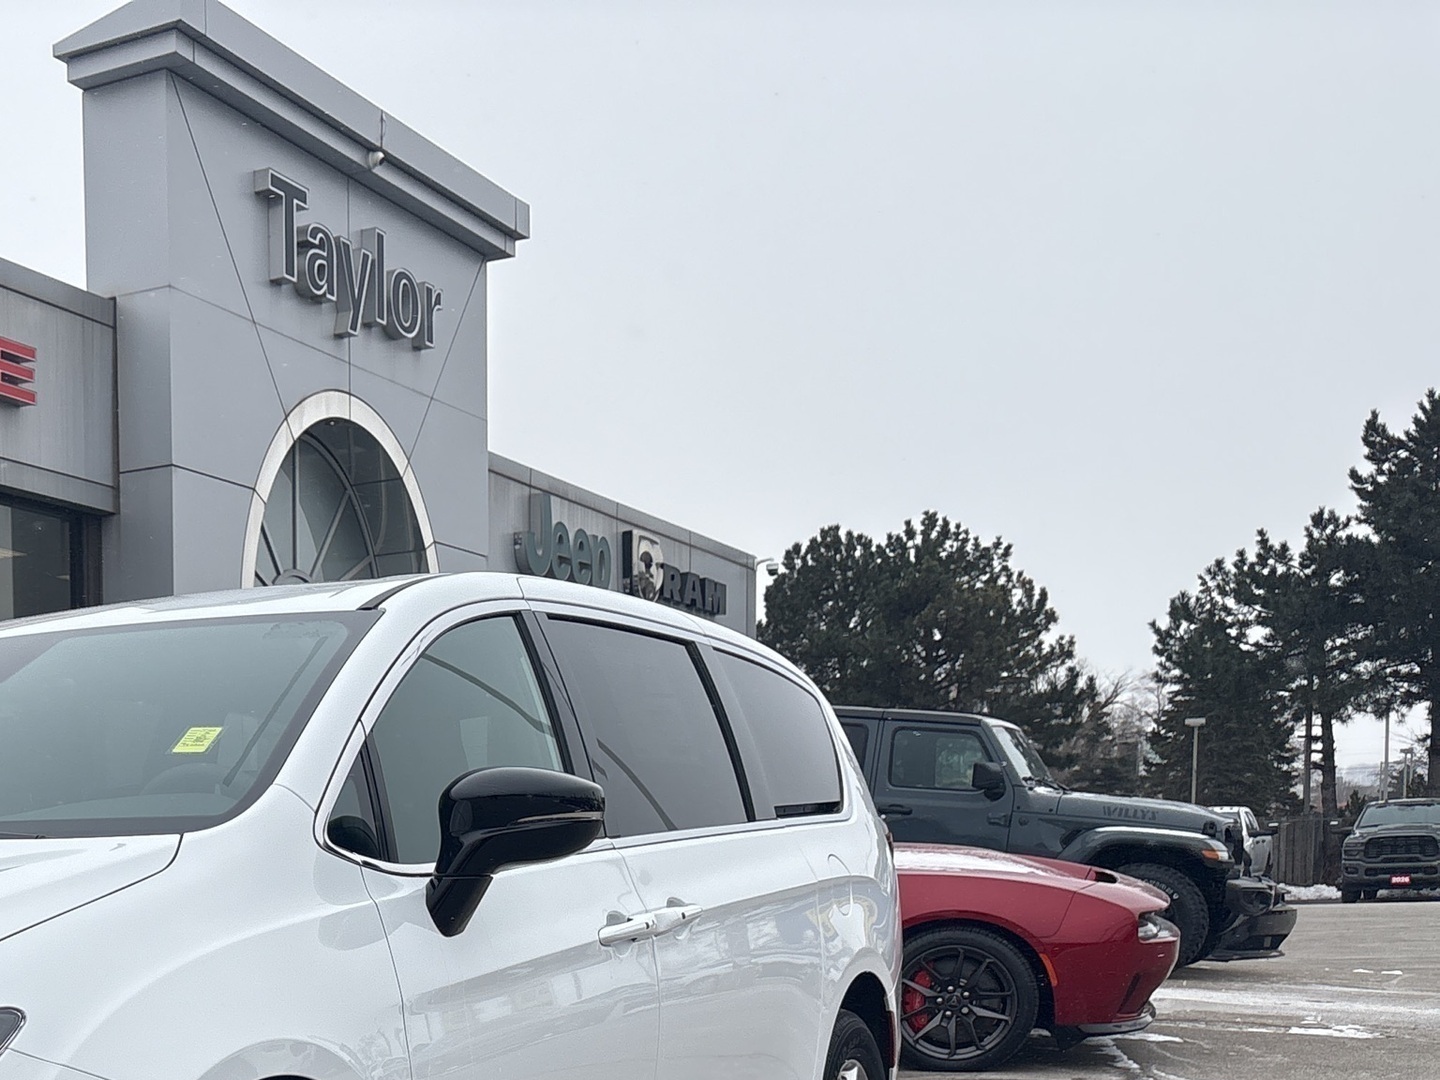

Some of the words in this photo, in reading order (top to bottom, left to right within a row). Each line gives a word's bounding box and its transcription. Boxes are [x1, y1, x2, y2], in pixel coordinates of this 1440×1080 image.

[254, 167, 443, 349] Taylor
[660, 562, 726, 615] RAM
[1102, 805, 1159, 821] WILLYS
